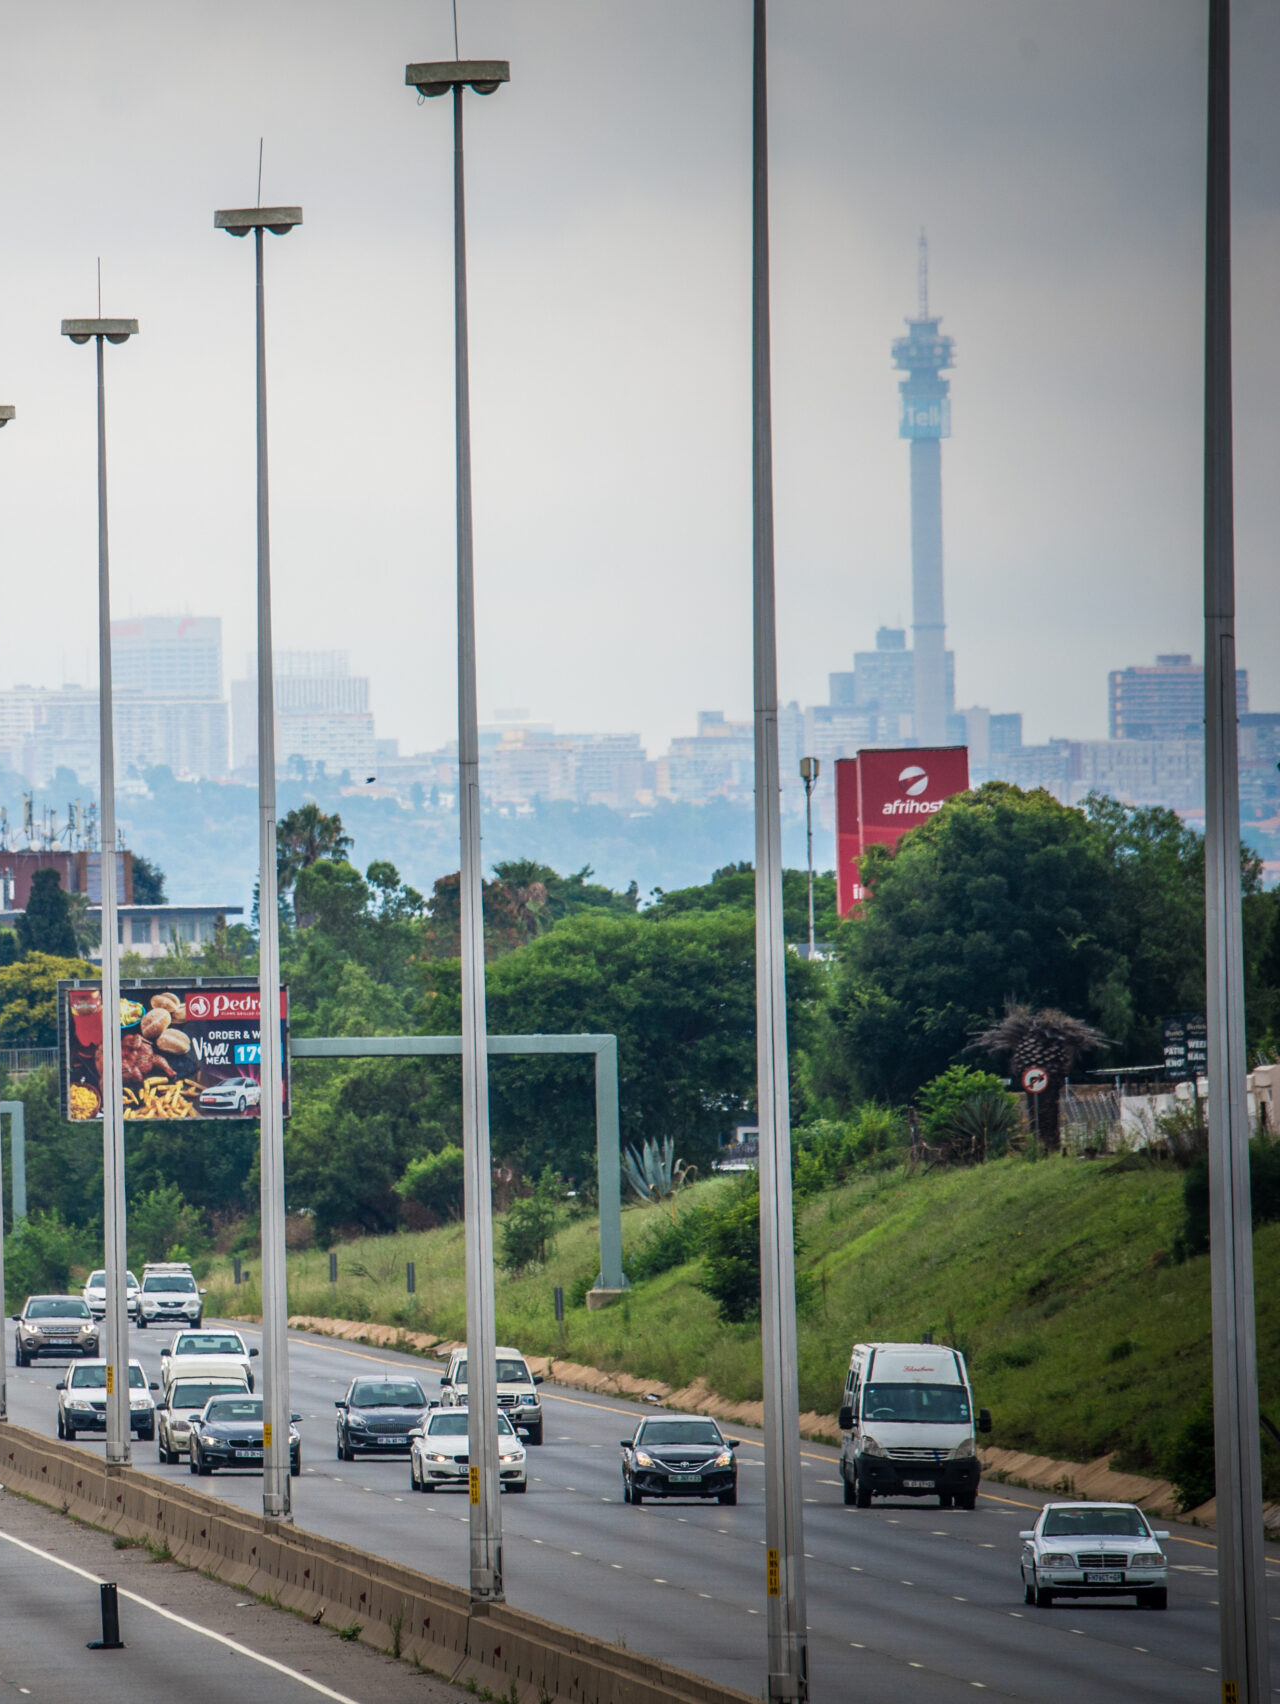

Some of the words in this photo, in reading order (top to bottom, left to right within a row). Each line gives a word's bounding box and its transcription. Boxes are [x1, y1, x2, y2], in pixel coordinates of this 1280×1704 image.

[882, 799, 944, 815] afrihost
[213, 995, 261, 1017] Pedr
[208, 1031, 241, 1040] ORDER
[243, 1031, 250, 1039] &
[192, 1036, 230, 1061] Viva
[206, 1056, 232, 1065] MEAL
